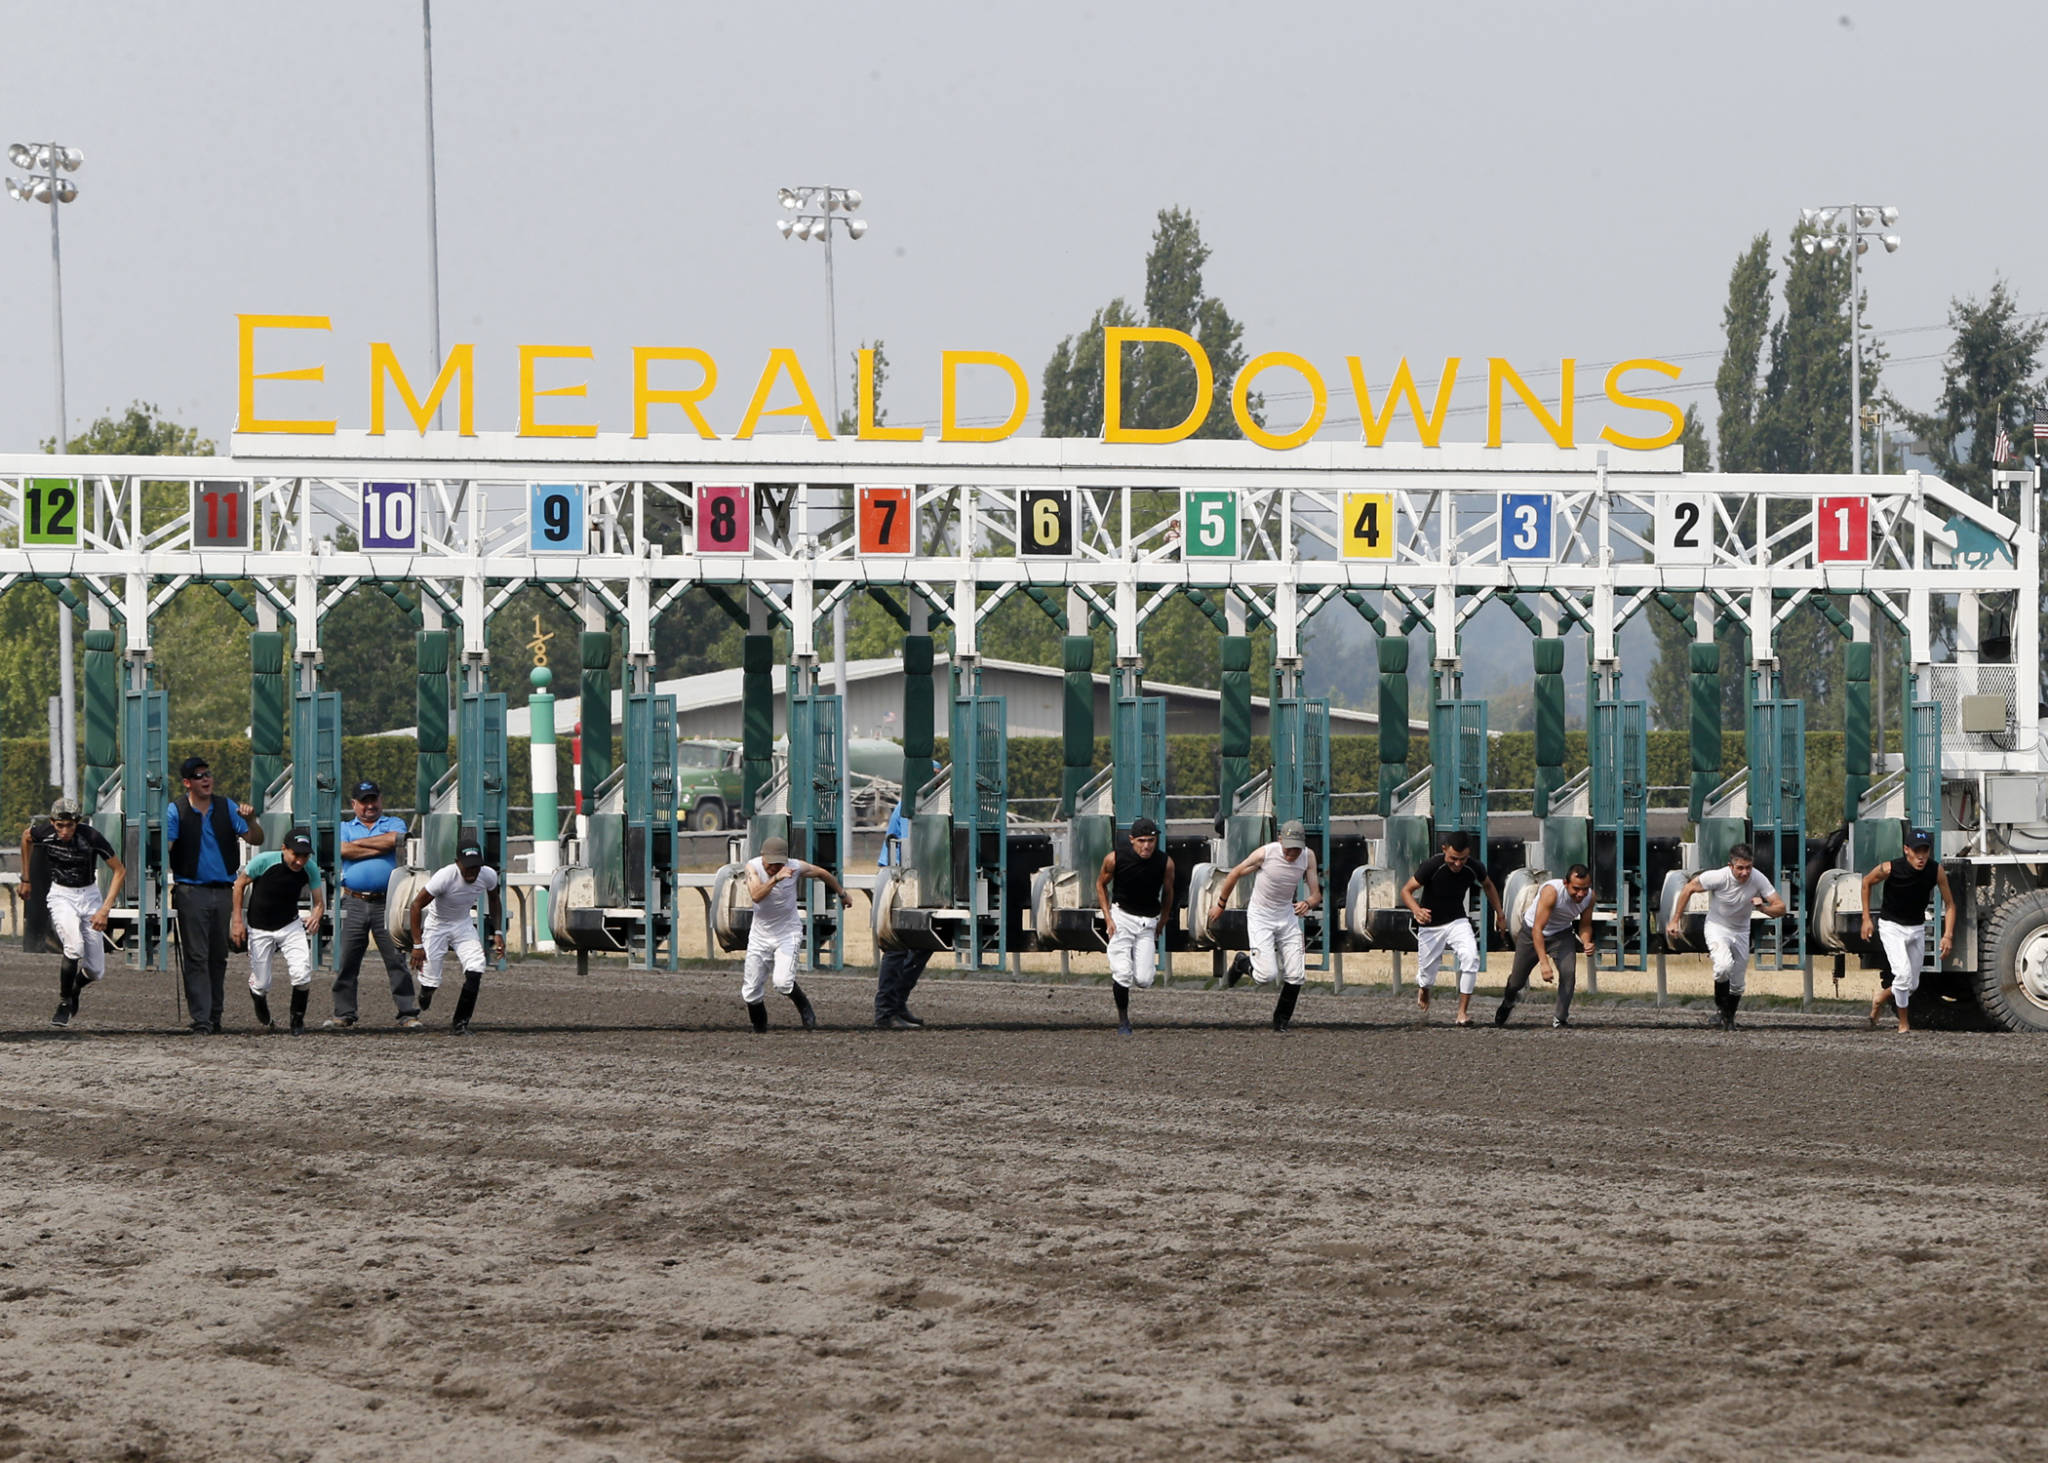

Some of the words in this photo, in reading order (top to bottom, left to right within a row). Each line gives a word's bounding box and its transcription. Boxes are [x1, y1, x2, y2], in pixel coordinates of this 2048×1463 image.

[236, 313, 1030, 443] EMERALD
[1102, 325, 1687, 451] DOWNS
[26, 488, 76, 535] 12
[204, 492, 237, 538] 11
[364, 488, 413, 540] 10
[544, 493, 571, 542] 9
[711, 495, 737, 543] 8
[874, 499, 897, 546] 7
[1032, 498, 1058, 546] 6
[1199, 501, 1225, 548] 5
[1354, 502, 1380, 548] 4
[1513, 504, 1538, 550] 3
[1674, 501, 1700, 549] 2
[1834, 506, 1849, 551] 1
